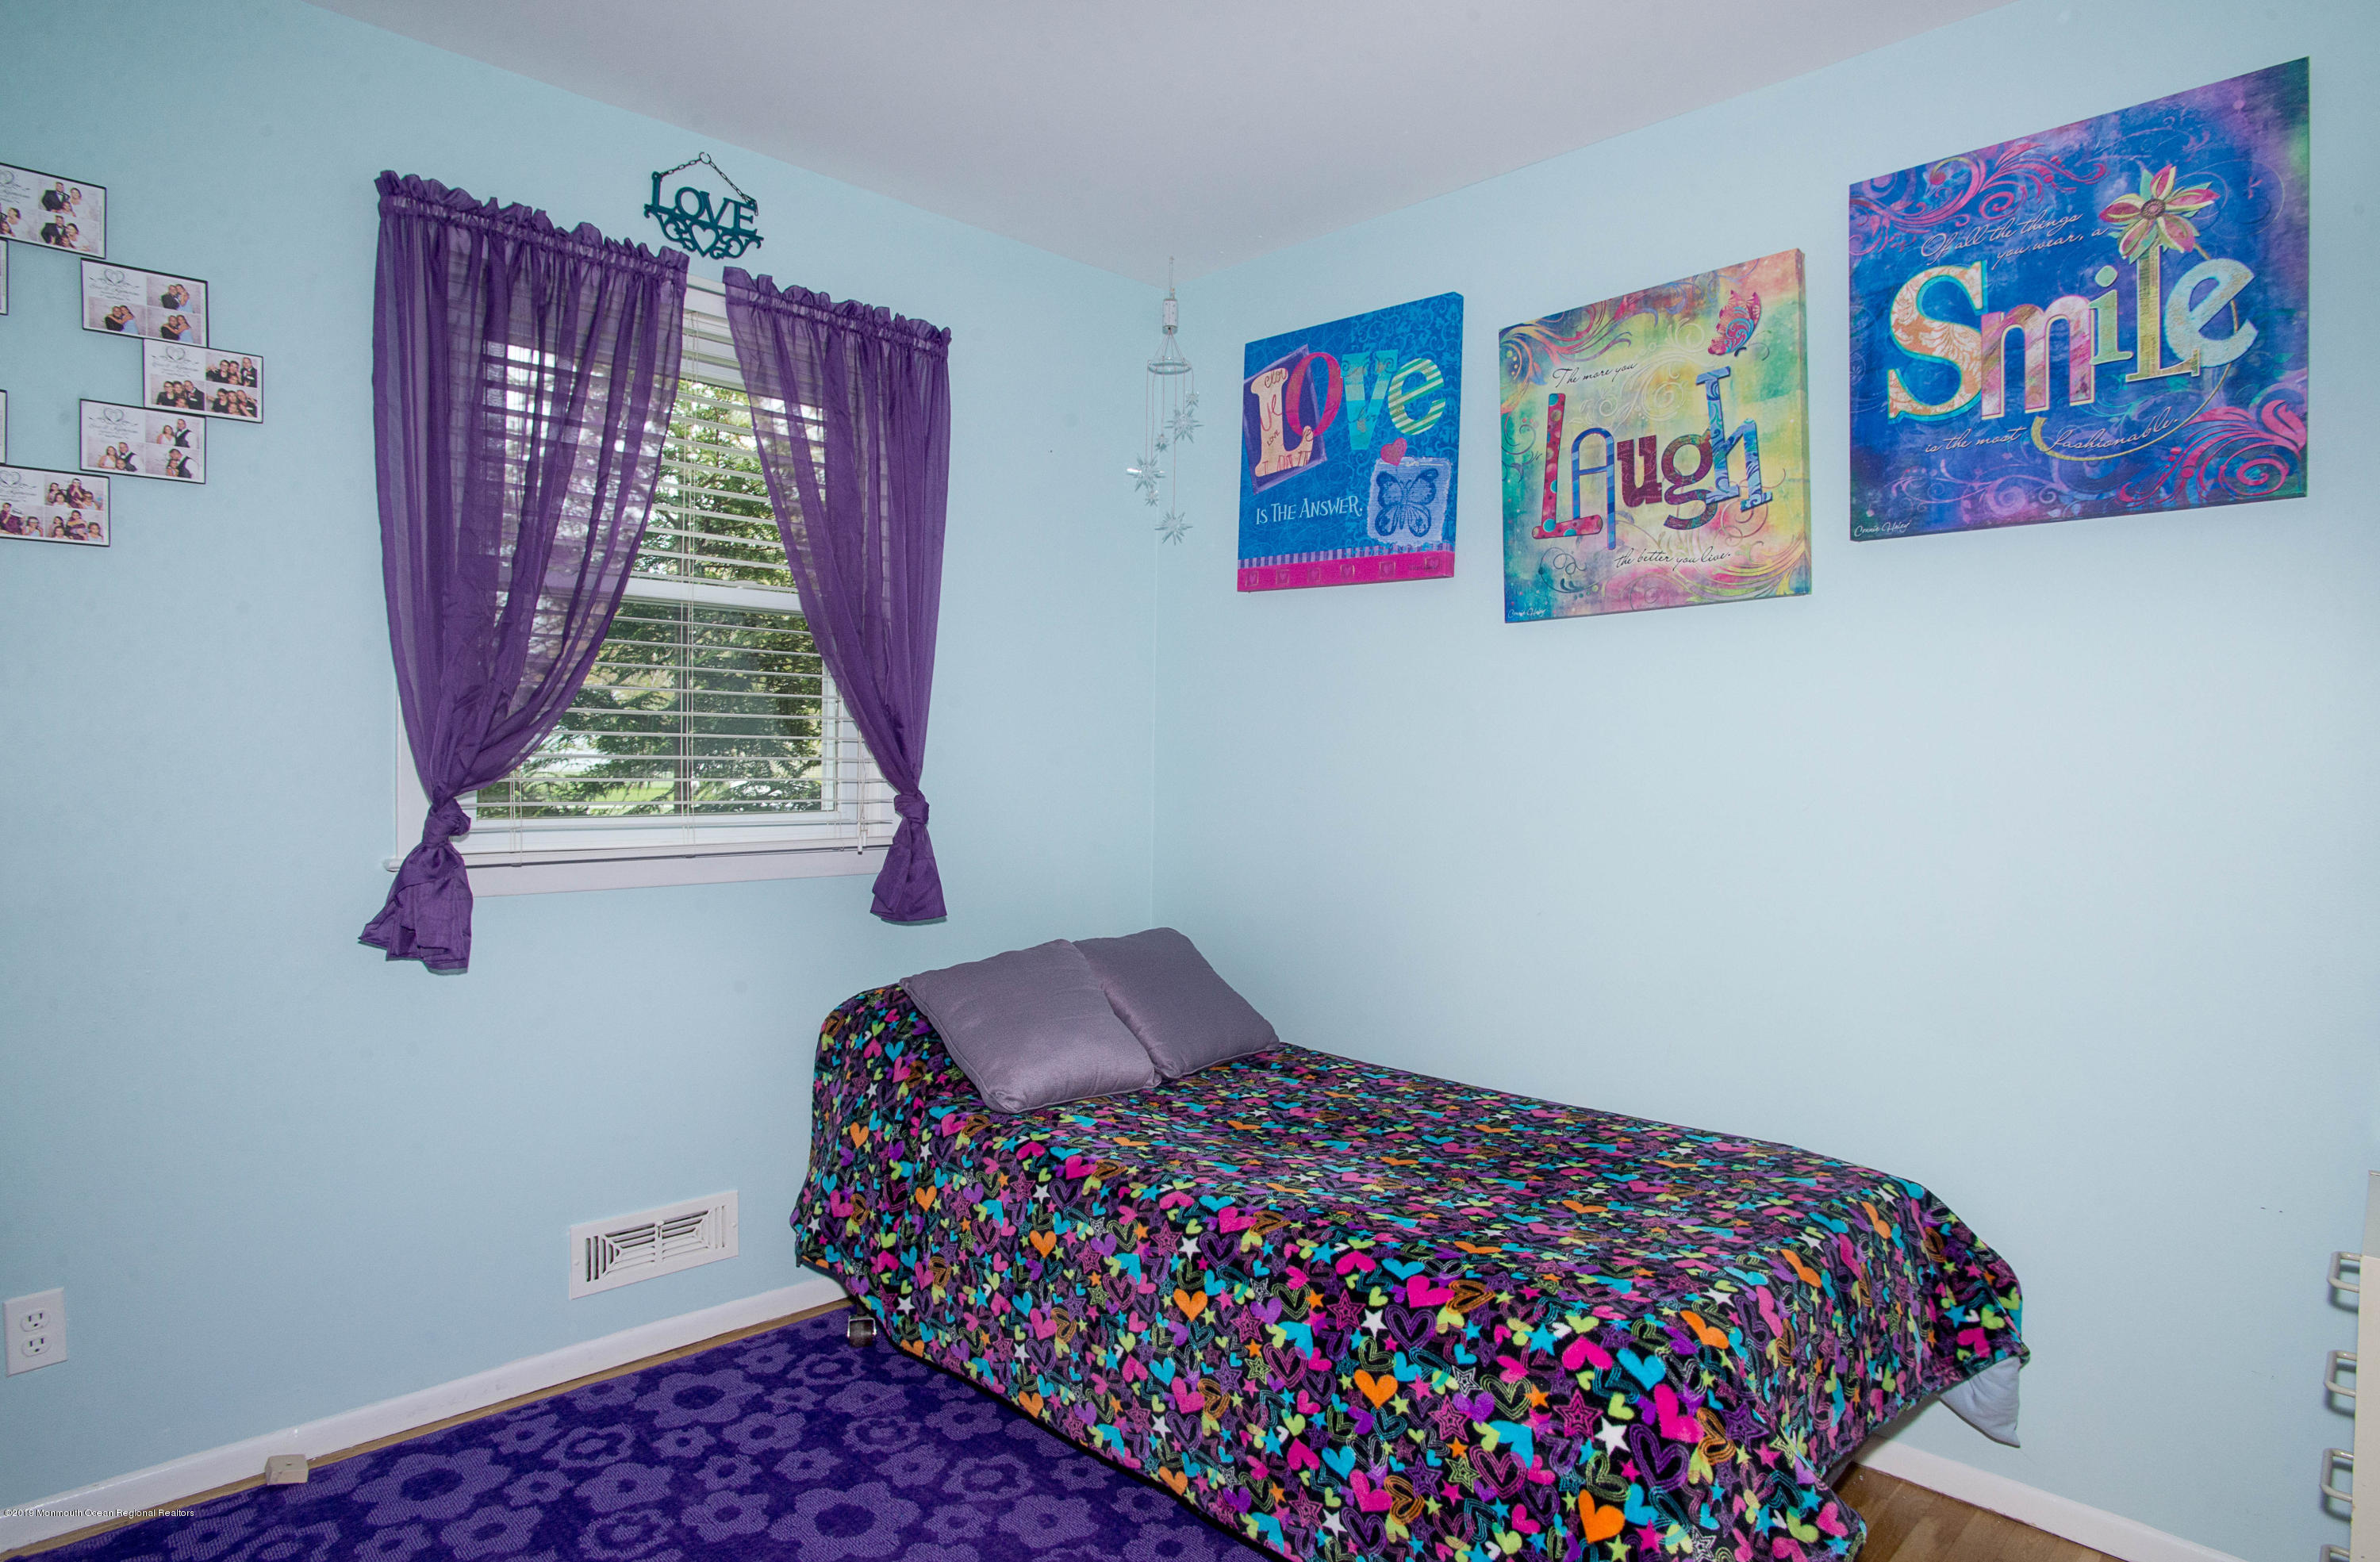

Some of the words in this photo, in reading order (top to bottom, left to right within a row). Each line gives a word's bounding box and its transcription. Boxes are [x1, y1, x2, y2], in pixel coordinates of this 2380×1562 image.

[647, 171, 758, 236] LOVE
[1921, 232, 1960, 266] Of
[1954, 224, 1988, 250] all
[1986, 217, 2017, 241] the
[2017, 209, 2084, 237] things
[1991, 245, 2032, 271] you
[2032, 232, 2084, 251] wear,
[2090, 228, 2110, 237] a
[1552, 367, 1580, 389] The
[1582, 369, 1614, 382] more
[1611, 363, 1638, 382] you
[1925, 443, 1942, 455] is
[1940, 428, 1973, 451] the
[1975, 427, 2028, 446] most
[2044, 405, 2178, 452] fashionable.
[1270, 502, 1297, 523] THE
[1614, 547, 1636, 568] the
[1637, 548, 1674, 563] better
[1672, 556, 1700, 571] you
[1700, 546, 1731, 562] live.
